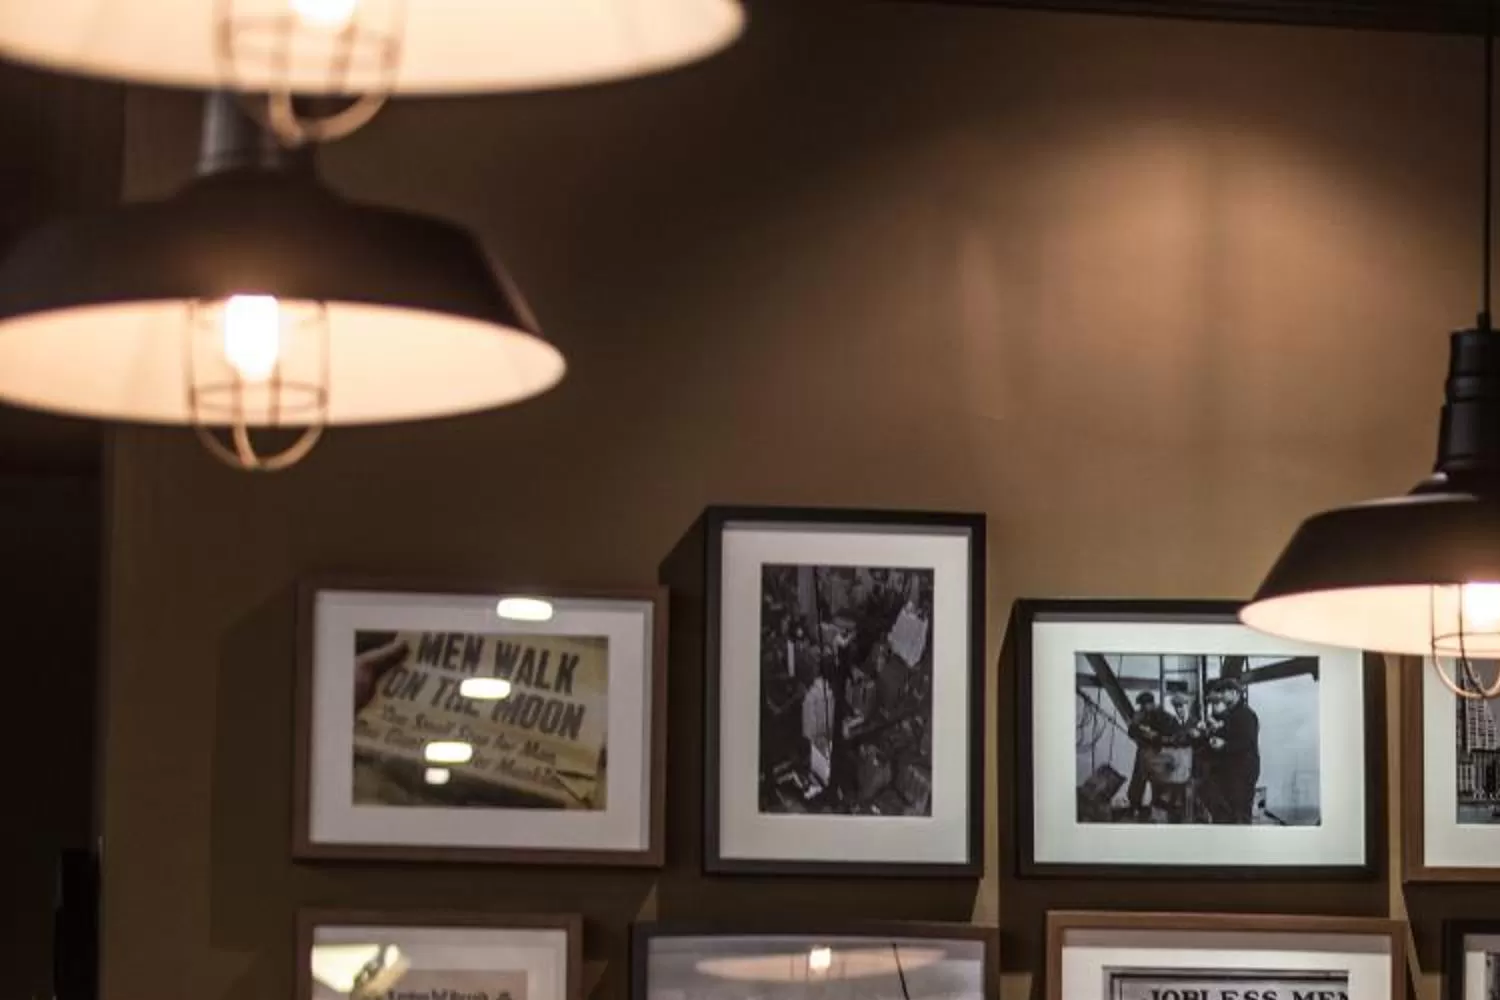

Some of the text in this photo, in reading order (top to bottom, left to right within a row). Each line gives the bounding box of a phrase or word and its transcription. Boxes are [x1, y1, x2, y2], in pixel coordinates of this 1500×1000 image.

[415, 632, 580, 696] MEN WALK
[382, 667, 429, 701] ON
[491, 691, 585, 740] MOON
